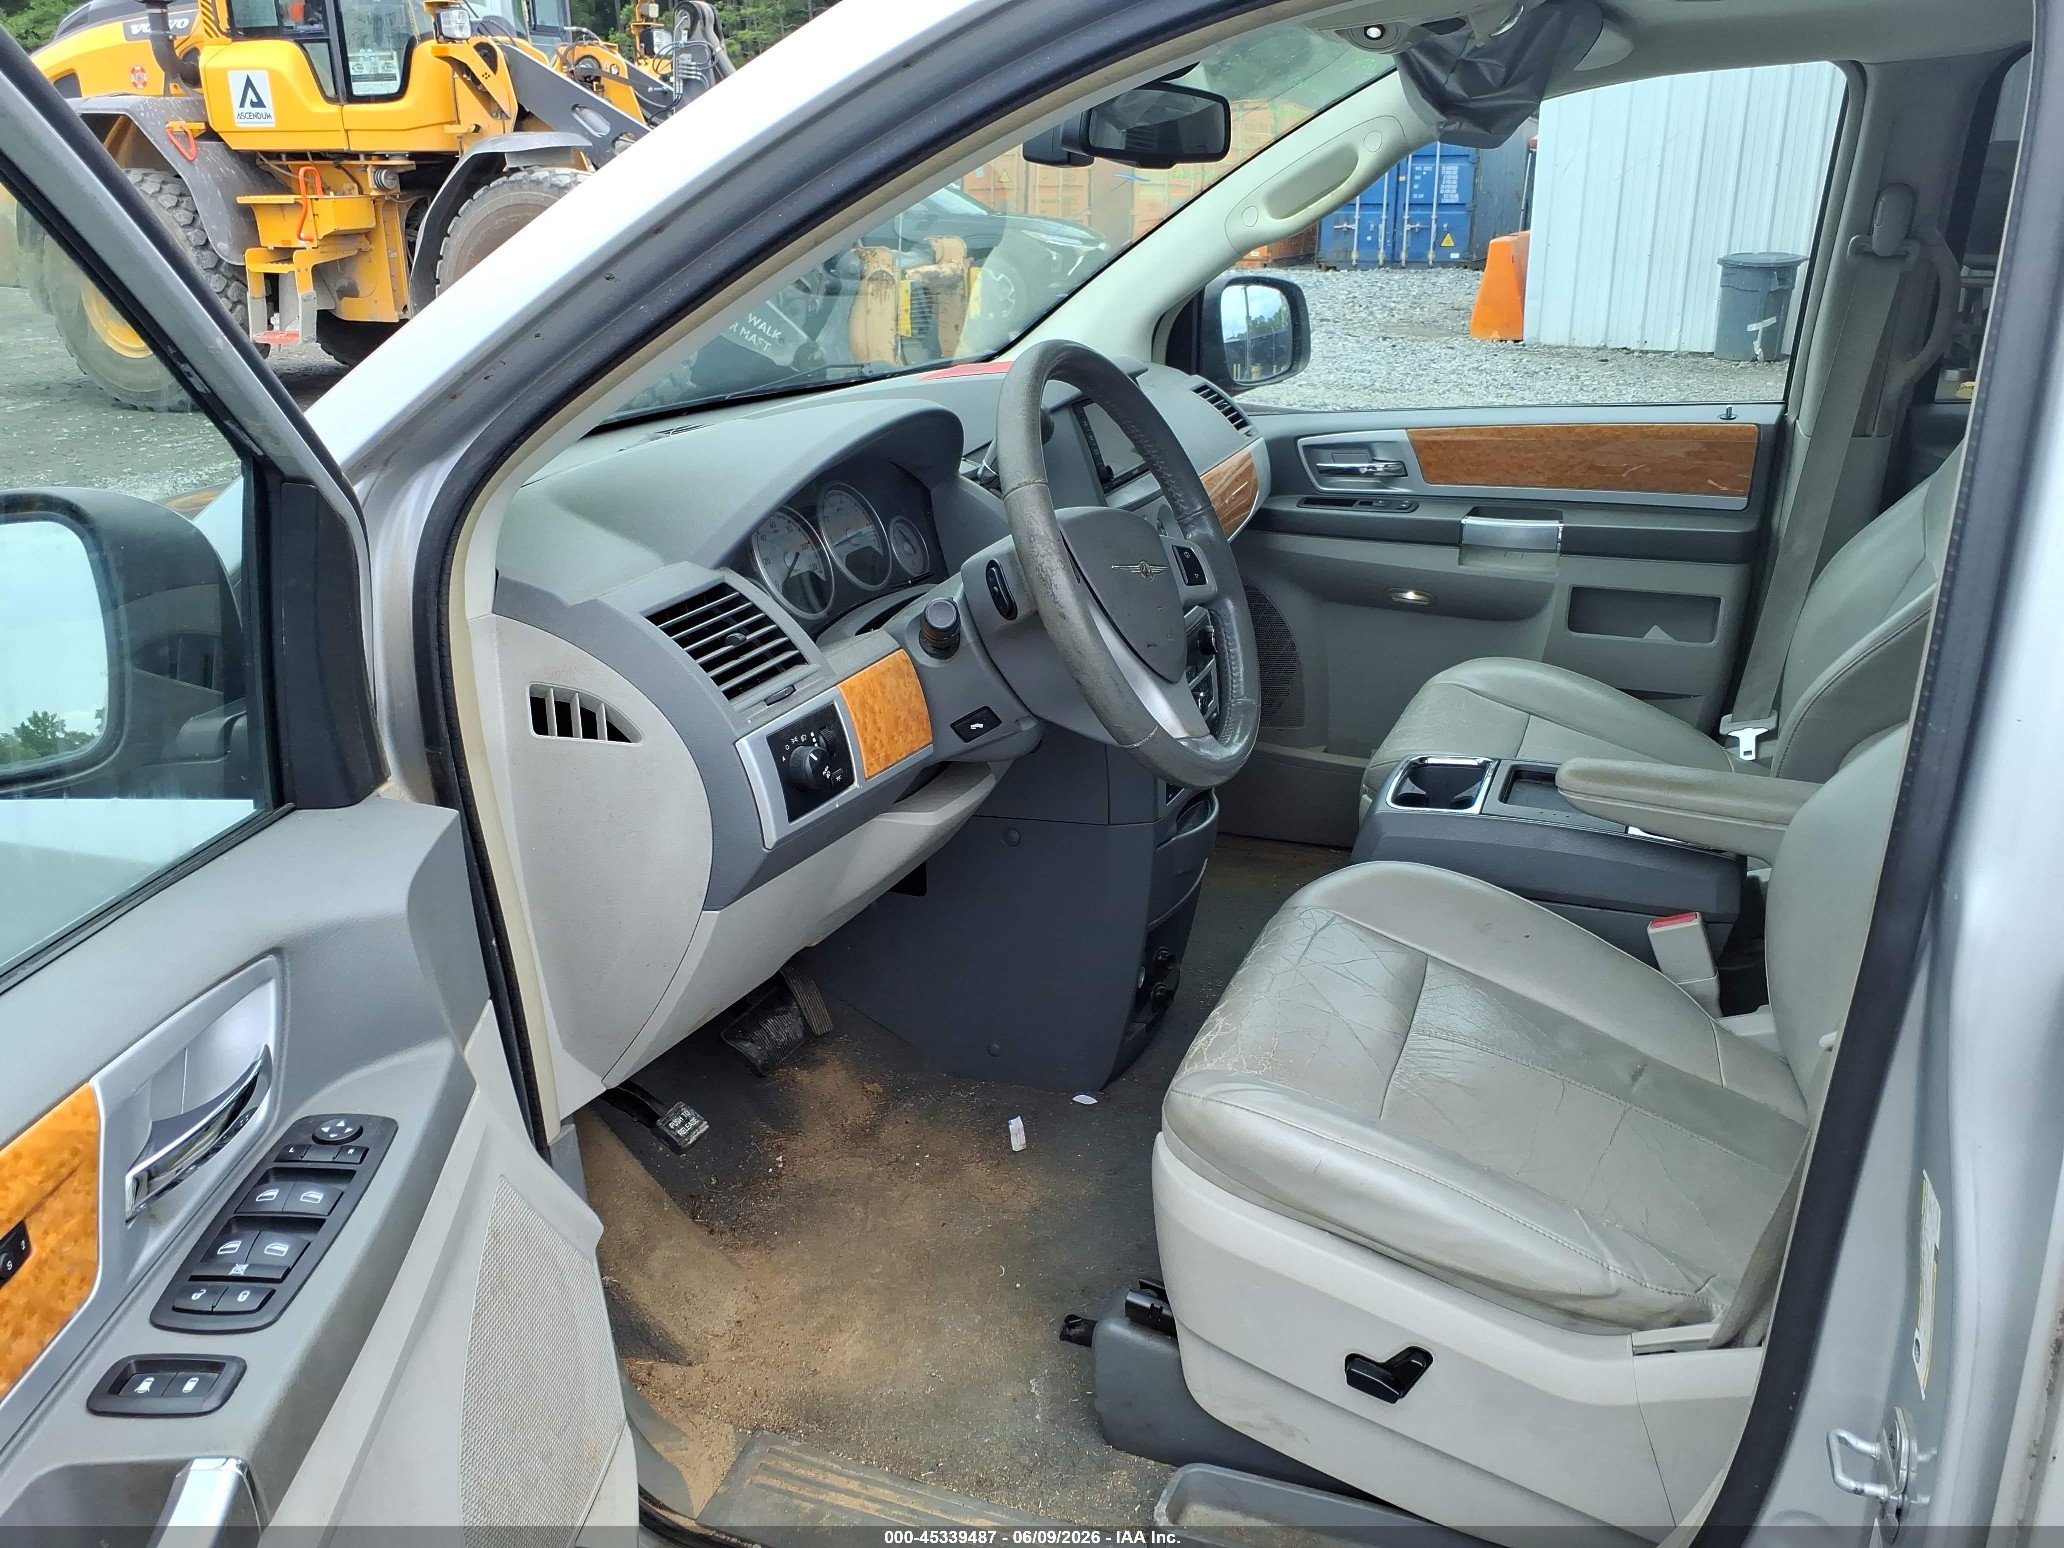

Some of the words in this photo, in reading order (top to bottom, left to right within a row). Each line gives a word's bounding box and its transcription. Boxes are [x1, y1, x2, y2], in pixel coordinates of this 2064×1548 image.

[130, 18, 190, 35] VOVO
[236, 111, 273, 120] ASCENDUM
[748, 312, 782, 340] WALK
[739, 326, 772, 352] MAST
[668, 1115, 684, 1129] PUSH
[677, 1116, 700, 1137] RELEASE
